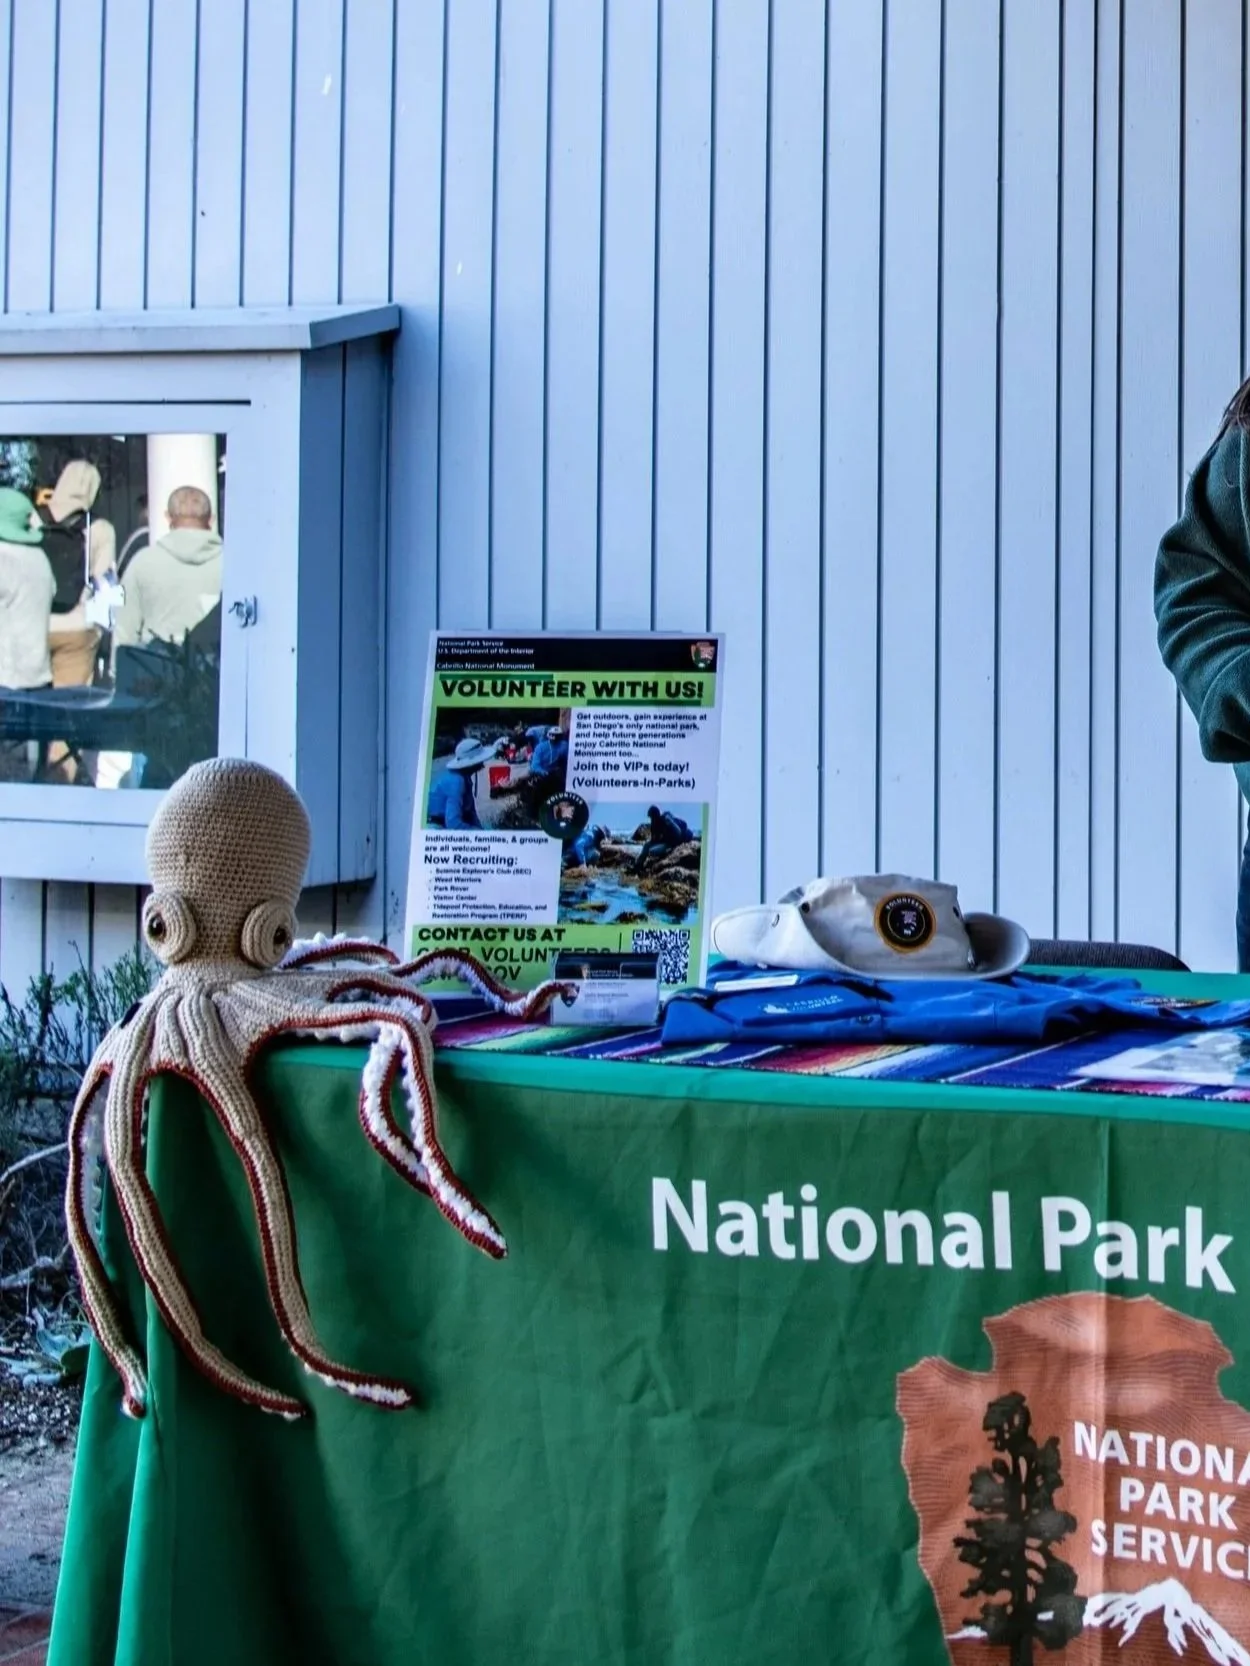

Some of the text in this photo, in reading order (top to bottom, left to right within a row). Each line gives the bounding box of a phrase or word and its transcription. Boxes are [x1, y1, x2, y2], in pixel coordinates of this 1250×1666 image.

[441, 680, 704, 698] VOLUNTEER WITH US!
[634, 713, 651, 722] gain
[654, 714, 697, 722] experience
[594, 722, 624, 730] Diego's
[626, 722, 643, 731] only
[592, 732, 610, 740] help
[638, 732, 686, 740] generations
[575, 740, 596, 750] enjoy
[574, 762, 689, 774] Join the VIPs today!
[572, 778, 696, 790] (Volunteers-In-Parks)
[546, 791, 583, 805] VOLUNTEER
[426, 835, 472, 844] Individuals,
[474, 836, 508, 844] families,
[520, 836, 548, 845] groups
[424, 854, 518, 866] Now Recruiting:
[418, 928, 565, 941] CONTACT US AT
[651, 1177, 1013, 1269] National
[1040, 1195, 1235, 1294] Park
[1120, 1478, 1238, 1530] PARK
